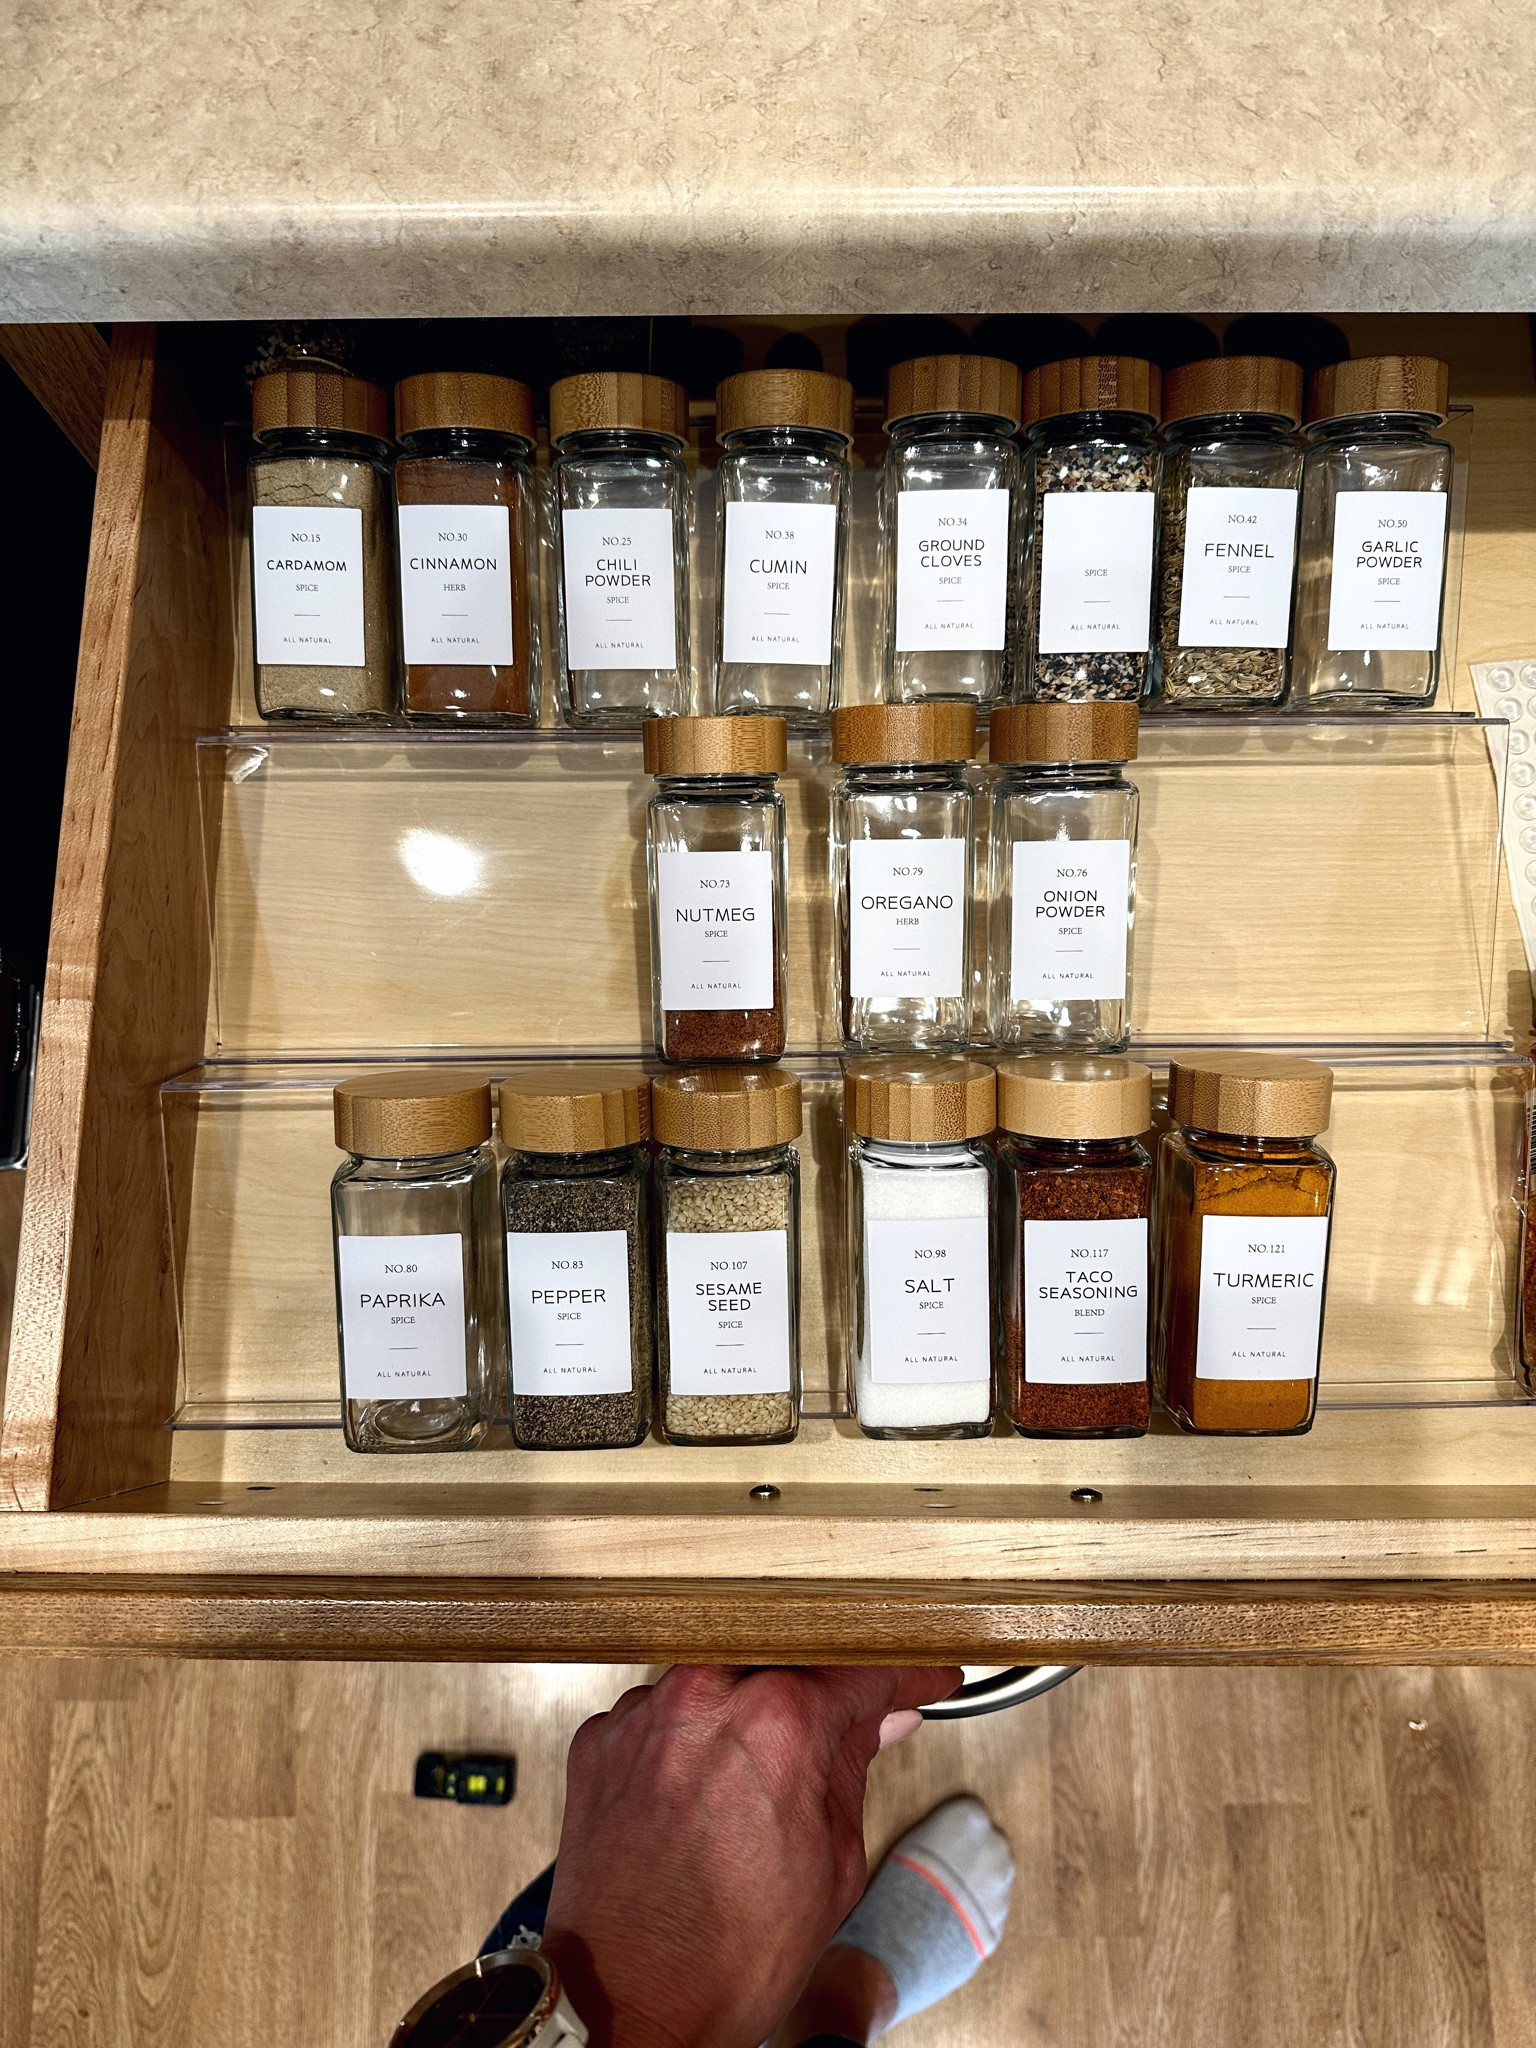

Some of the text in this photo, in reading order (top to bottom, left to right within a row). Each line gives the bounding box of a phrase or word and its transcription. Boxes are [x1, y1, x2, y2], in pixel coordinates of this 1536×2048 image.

[938, 517, 968, 527] NO.34
[1227, 514, 1258, 524] NO.42
[1377, 518, 1408, 529] NO.50
[291, 533, 321, 543] NO.15
[437, 532, 468, 542] NO.30
[765, 530, 795, 540] NO.38
[602, 536, 632, 546] NO.25
[918, 538, 985, 553] GROUND
[1204, 543, 1275, 559] FENNEL
[1361, 540, 1419, 553] GARLIC
[266, 559, 347, 572] CARDAMOM
[409, 557, 497, 571] CINNAMON
[596, 558, 637, 572] CHILI
[920, 554, 982, 568] CLOVES
[1356, 556, 1423, 569] POWDER
[749, 559, 807, 575] CUMIN
[1227, 565, 1251, 574] SPICE
[1084, 568, 1108, 577] SPICE
[585, 574, 651, 587] POWDER
[767, 581, 790, 590] SPICE
[938, 576, 962, 585] SPICE
[1377, 577, 1401, 586] SPICE
[295, 583, 319, 592] SPICE
[443, 583, 466, 592] HERB
[606, 596, 630, 605] SPICE
[940, 622, 974, 630] NATURAL
[1086, 623, 1120, 631] NATURAL
[1225, 618, 1259, 626] NATURAL
[1376, 622, 1409, 630] NATURAL
[283, 636, 332, 644] ALL NATURAL
[767, 635, 800, 643] NATURAL
[610, 641, 644, 649] NATURAL
[892, 866, 924, 876] NO.79
[1056, 868, 1088, 878] NO.76
[699, 879, 731, 889] NO.73
[1043, 889, 1098, 903] ONION
[861, 894, 954, 910] OREGANO
[676, 907, 755, 923] NUTMEG
[1035, 905, 1105, 918] POWDER
[896, 917, 920, 926] HERB
[704, 929, 729, 938] SPICE
[1058, 927, 1083, 935] SPICE
[1059, 972, 1094, 980] NATURAL
[707, 982, 741, 990] NATURAL
[1070, 1248, 1109, 1258] NO.117
[1247, 1243, 1285, 1254] NO.121
[914, 1249, 947, 1259] NO.98
[384, 1264, 418, 1274] NO.80
[551, 1260, 584, 1270] NO.83
[710, 1260, 748, 1271] NO.107
[1065, 1270, 1113, 1284] TACO
[1212, 1272, 1314, 1288] TURMERIC
[695, 1281, 762, 1296] SESAME
[904, 1277, 955, 1294] SALT
[531, 1288, 606, 1305] PEPPER
[1038, 1285, 1138, 1300] SEASONING
[360, 1292, 446, 1309] PAPRIKA
[708, 1298, 751, 1312] SEED
[919, 1301, 944, 1310] SPICE
[1251, 1296, 1277, 1305] SPICE
[557, 1312, 582, 1321] SPICE
[1074, 1308, 1105, 1317] BLEND
[390, 1316, 416, 1325] SPICE
[718, 1320, 744, 1329] SPICE
[922, 1355, 959, 1363] NATURAL
[1231, 1350, 1247, 1358] ALL
[394, 1370, 432, 1378] NATURAL
[560, 1366, 597, 1374] NATURAL
